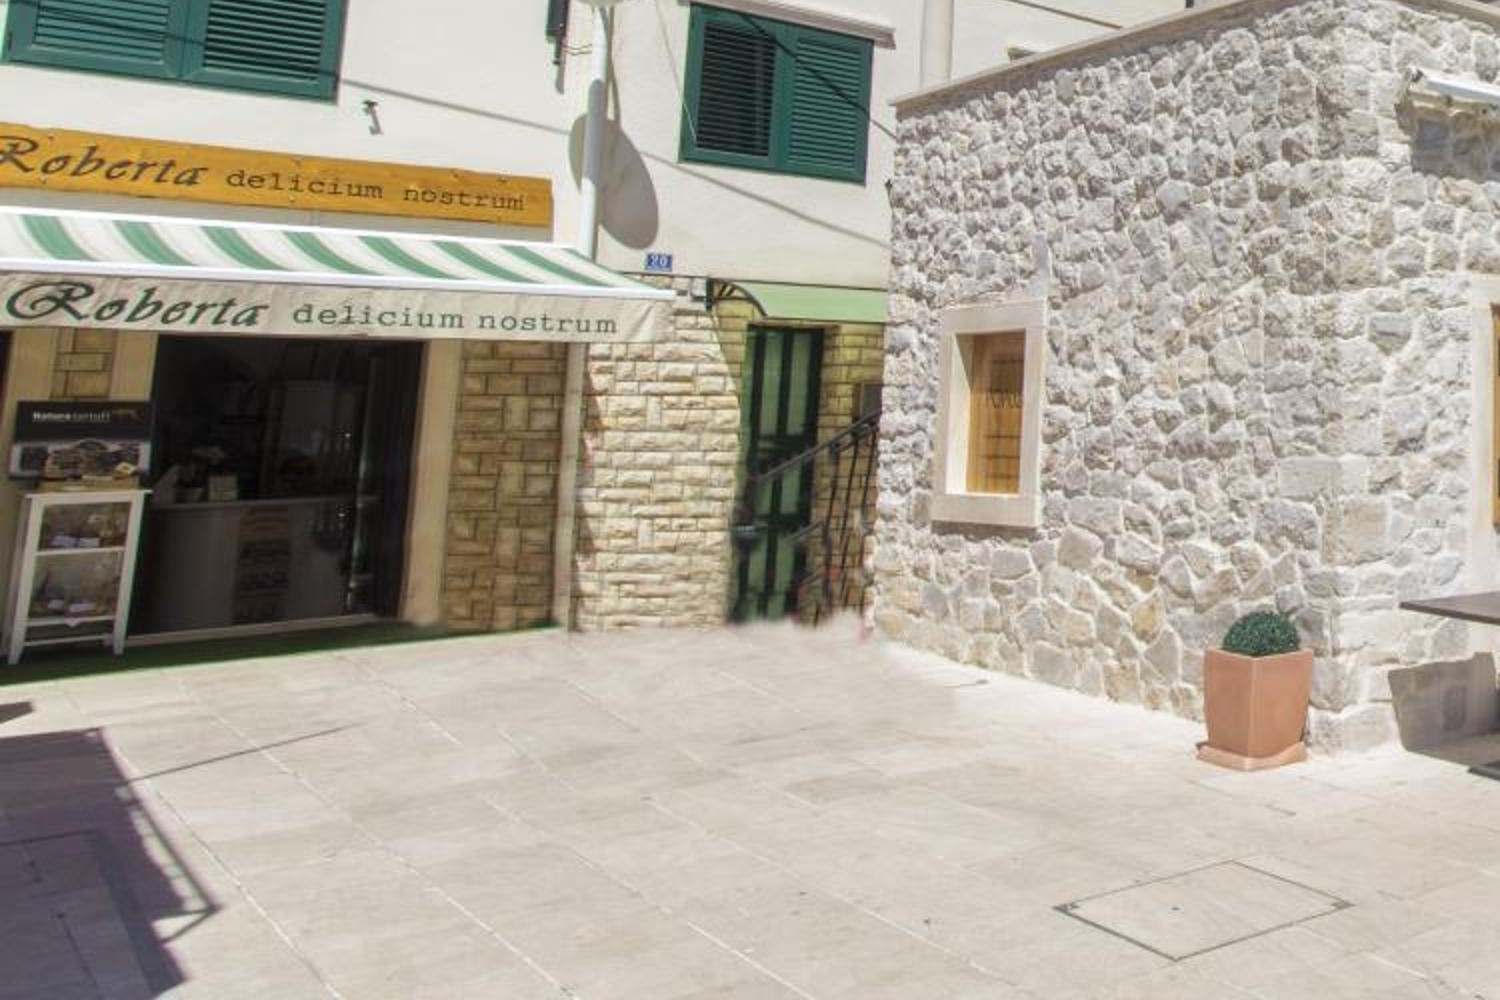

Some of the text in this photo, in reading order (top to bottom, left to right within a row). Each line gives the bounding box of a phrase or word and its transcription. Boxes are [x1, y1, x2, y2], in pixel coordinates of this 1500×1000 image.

[0, 135, 525, 212] Roberta delicium nostrum
[6, 281, 617, 334] Roberta delicium nostrum
